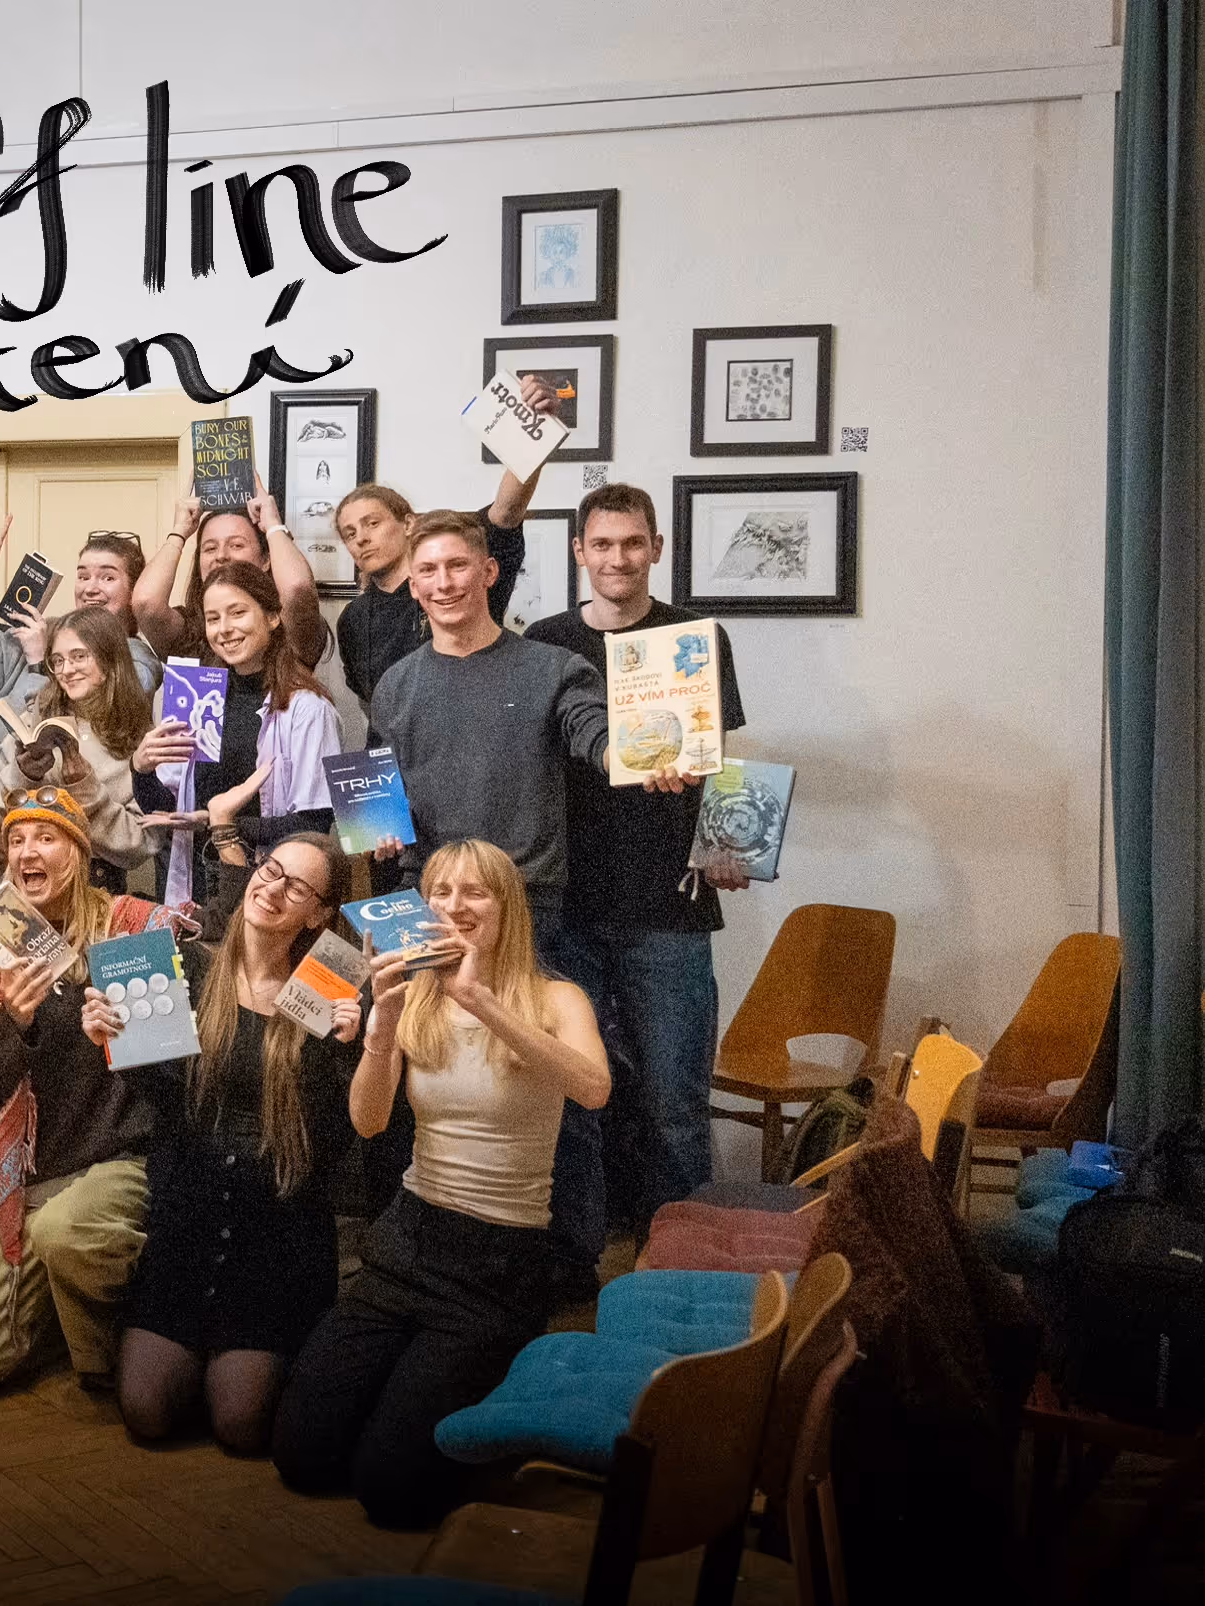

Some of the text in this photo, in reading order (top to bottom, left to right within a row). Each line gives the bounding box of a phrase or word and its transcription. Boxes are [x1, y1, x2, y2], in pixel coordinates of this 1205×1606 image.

[491, 382, 546, 441] Kmotr
[195, 420, 247, 434] BURY OUR
[196, 433, 241, 449] BONES
[197, 447, 249, 463] MIDNIGHT
[197, 462, 230, 478] SOIL
[615, 681, 711, 705] UŽ VÍM PROČ
[333, 772, 396, 792] TRHY
[360, 901, 413, 920] Coelho
[27, 926, 54, 951] Obraz
[47, 942, 66, 965] raye
[101, 955, 146, 972] INFORMAČNÍ
[102, 962, 152, 979] GRAMOTNOST
[288, 985, 322, 1016] Vládci
